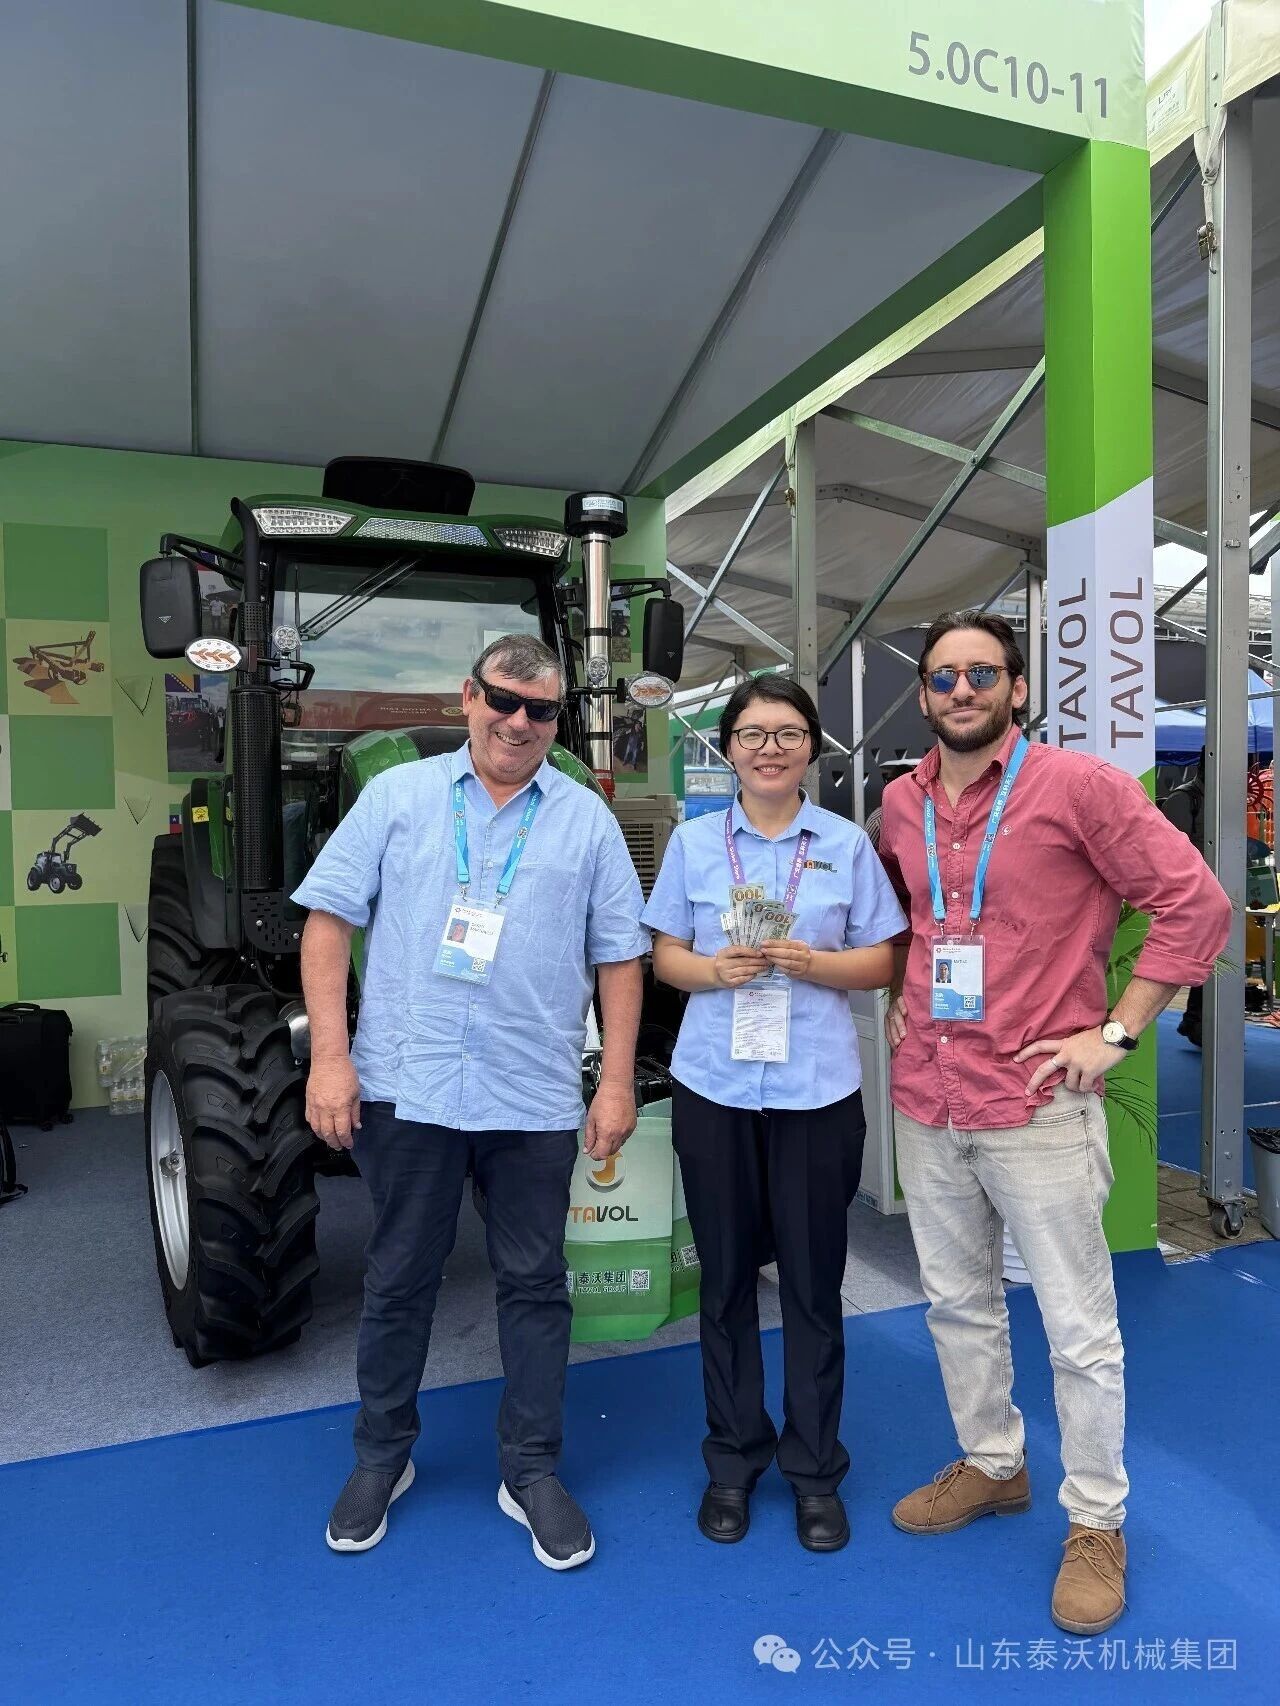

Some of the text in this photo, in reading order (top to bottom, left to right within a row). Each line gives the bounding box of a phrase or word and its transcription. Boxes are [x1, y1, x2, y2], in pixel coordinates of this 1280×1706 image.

[908, 31, 1107, 118] 5.0C10-11
[1058, 577, 1086, 748] TAVOL
[1109, 577, 1144, 748] TAVOL
[569, 1205, 639, 1224] TAVOL
[578, 1270, 627, 1285] 泰沃集团
